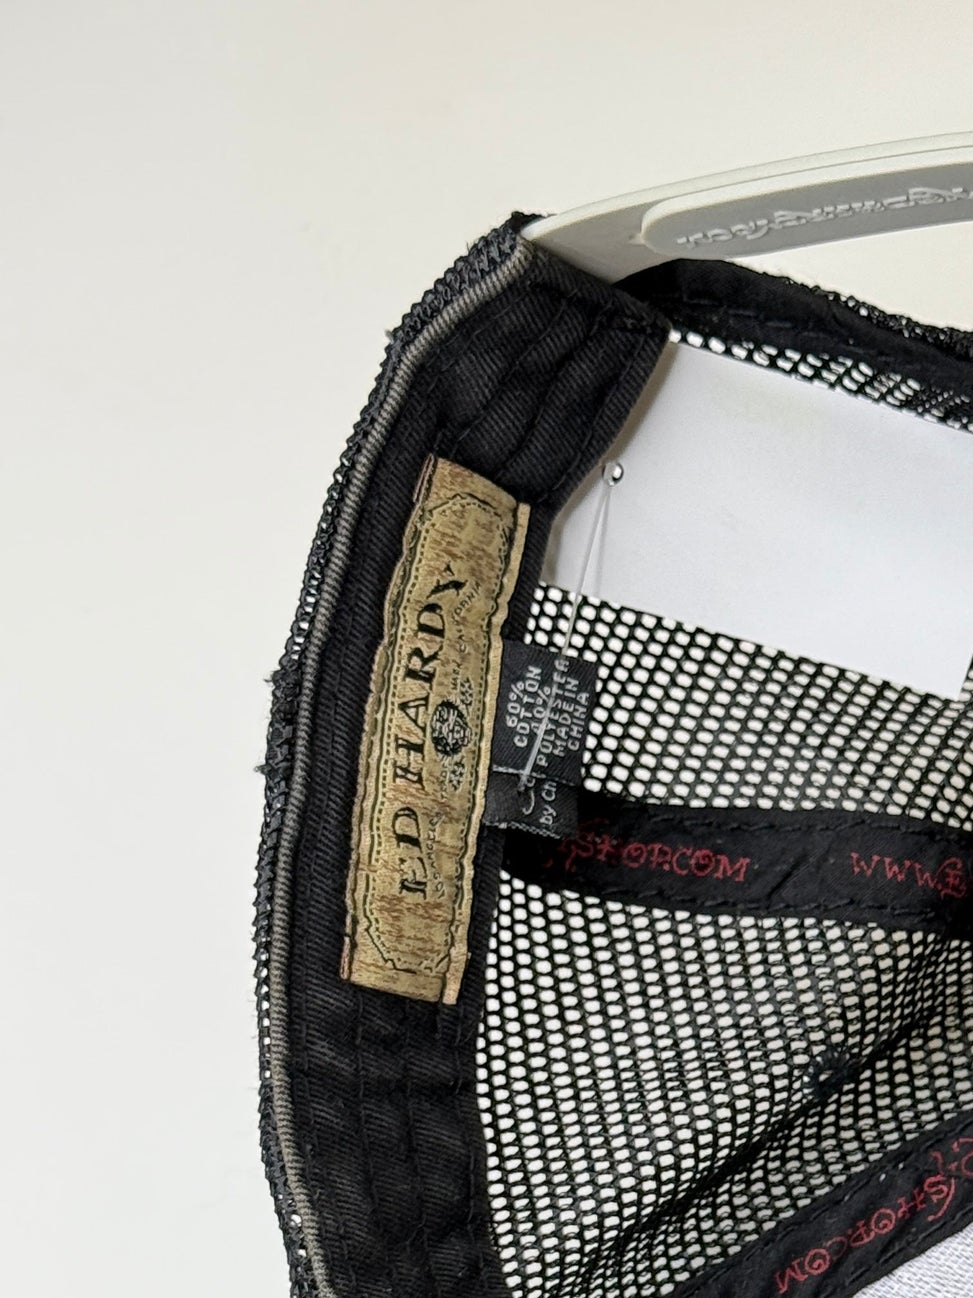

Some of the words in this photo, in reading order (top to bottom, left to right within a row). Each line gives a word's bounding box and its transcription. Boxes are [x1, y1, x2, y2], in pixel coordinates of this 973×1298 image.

[391, 560, 467, 791] HARDY
[505, 679, 526, 728] 60%
[563, 676, 579, 699] IN
[513, 664, 542, 749] COTTON
[536, 655, 570, 768] POLYESTER
[552, 701, 575, 757] MADE
[568, 691, 590, 752] CHINA
[539, 804, 557, 826] by
[391, 806, 428, 900] ED
